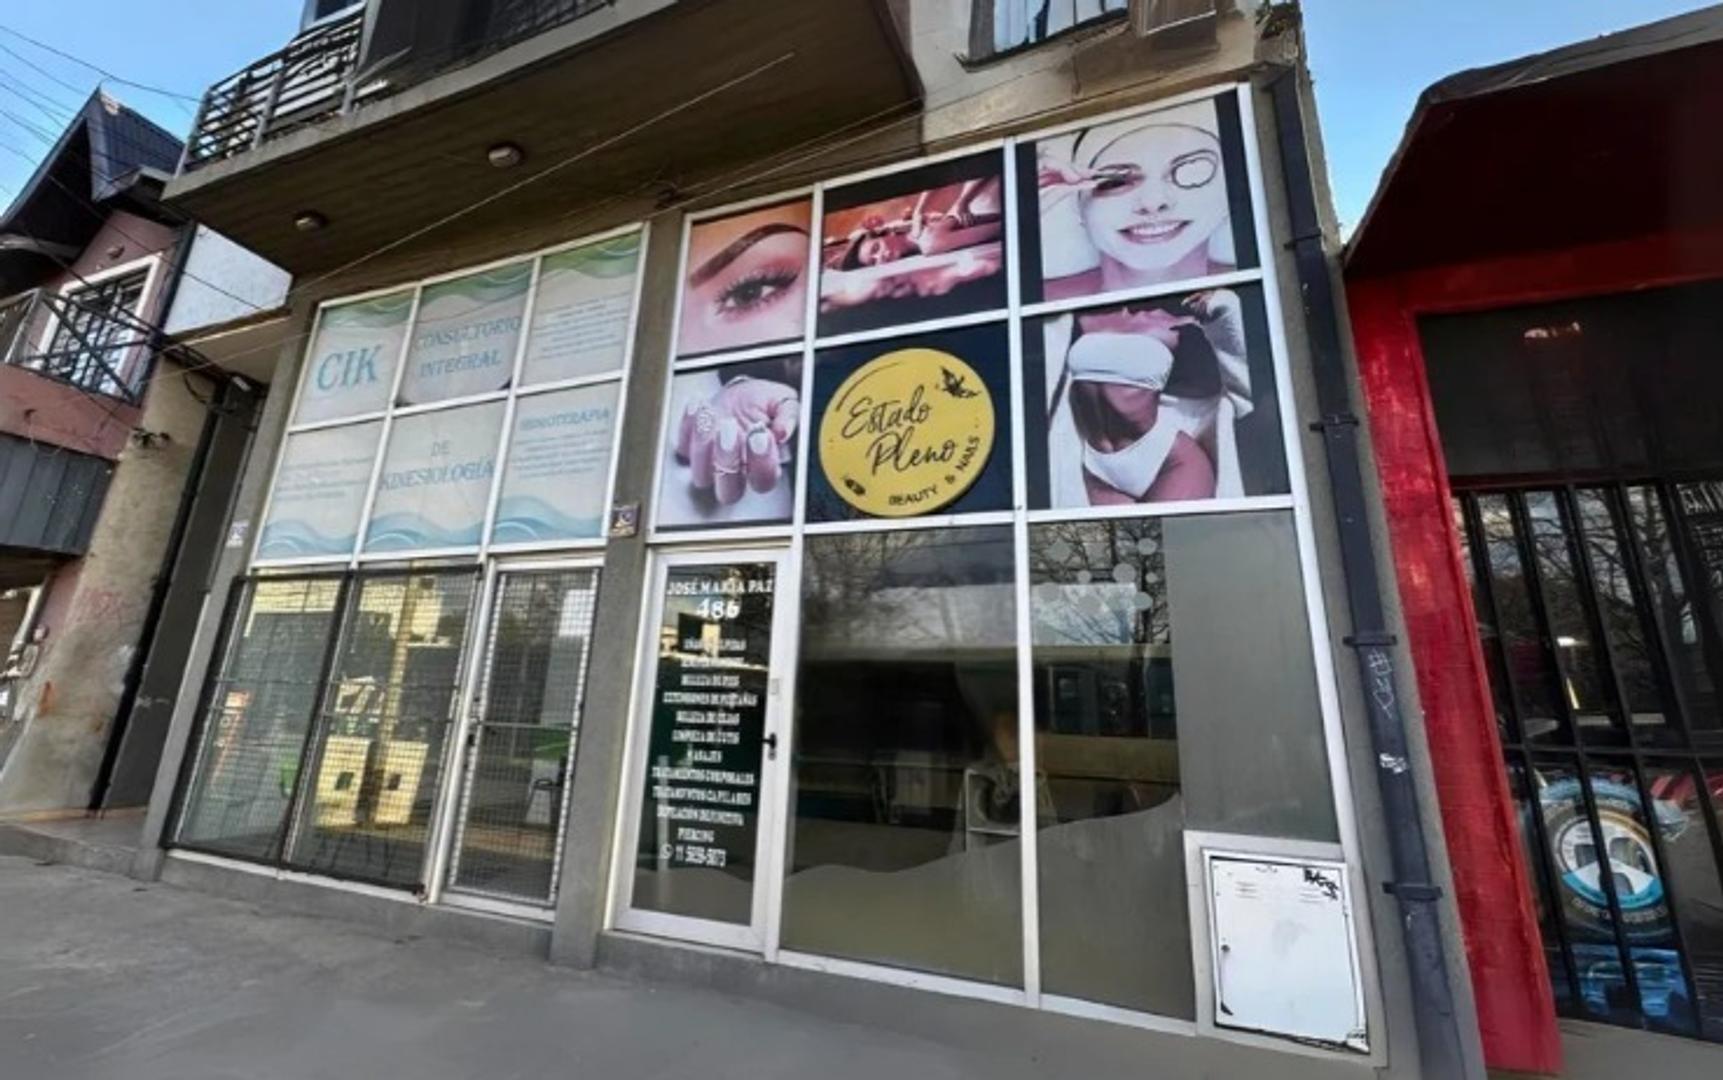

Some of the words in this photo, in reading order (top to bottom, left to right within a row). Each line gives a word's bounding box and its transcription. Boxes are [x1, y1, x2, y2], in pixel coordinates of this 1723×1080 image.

[316, 343, 383, 391] CIK
[419, 349, 502, 378] INTEGRAL
[841, 384, 932, 439] Estado
[431, 440, 451, 458] DE
[865, 426, 958, 476] Pleno
[888, 484, 938, 507] BEAUTY
[944, 474, 956, 485] &
[954, 436, 981, 472] NAILS
[747, 579, 774, 594] PAZ
[696, 598, 741, 619] 486
